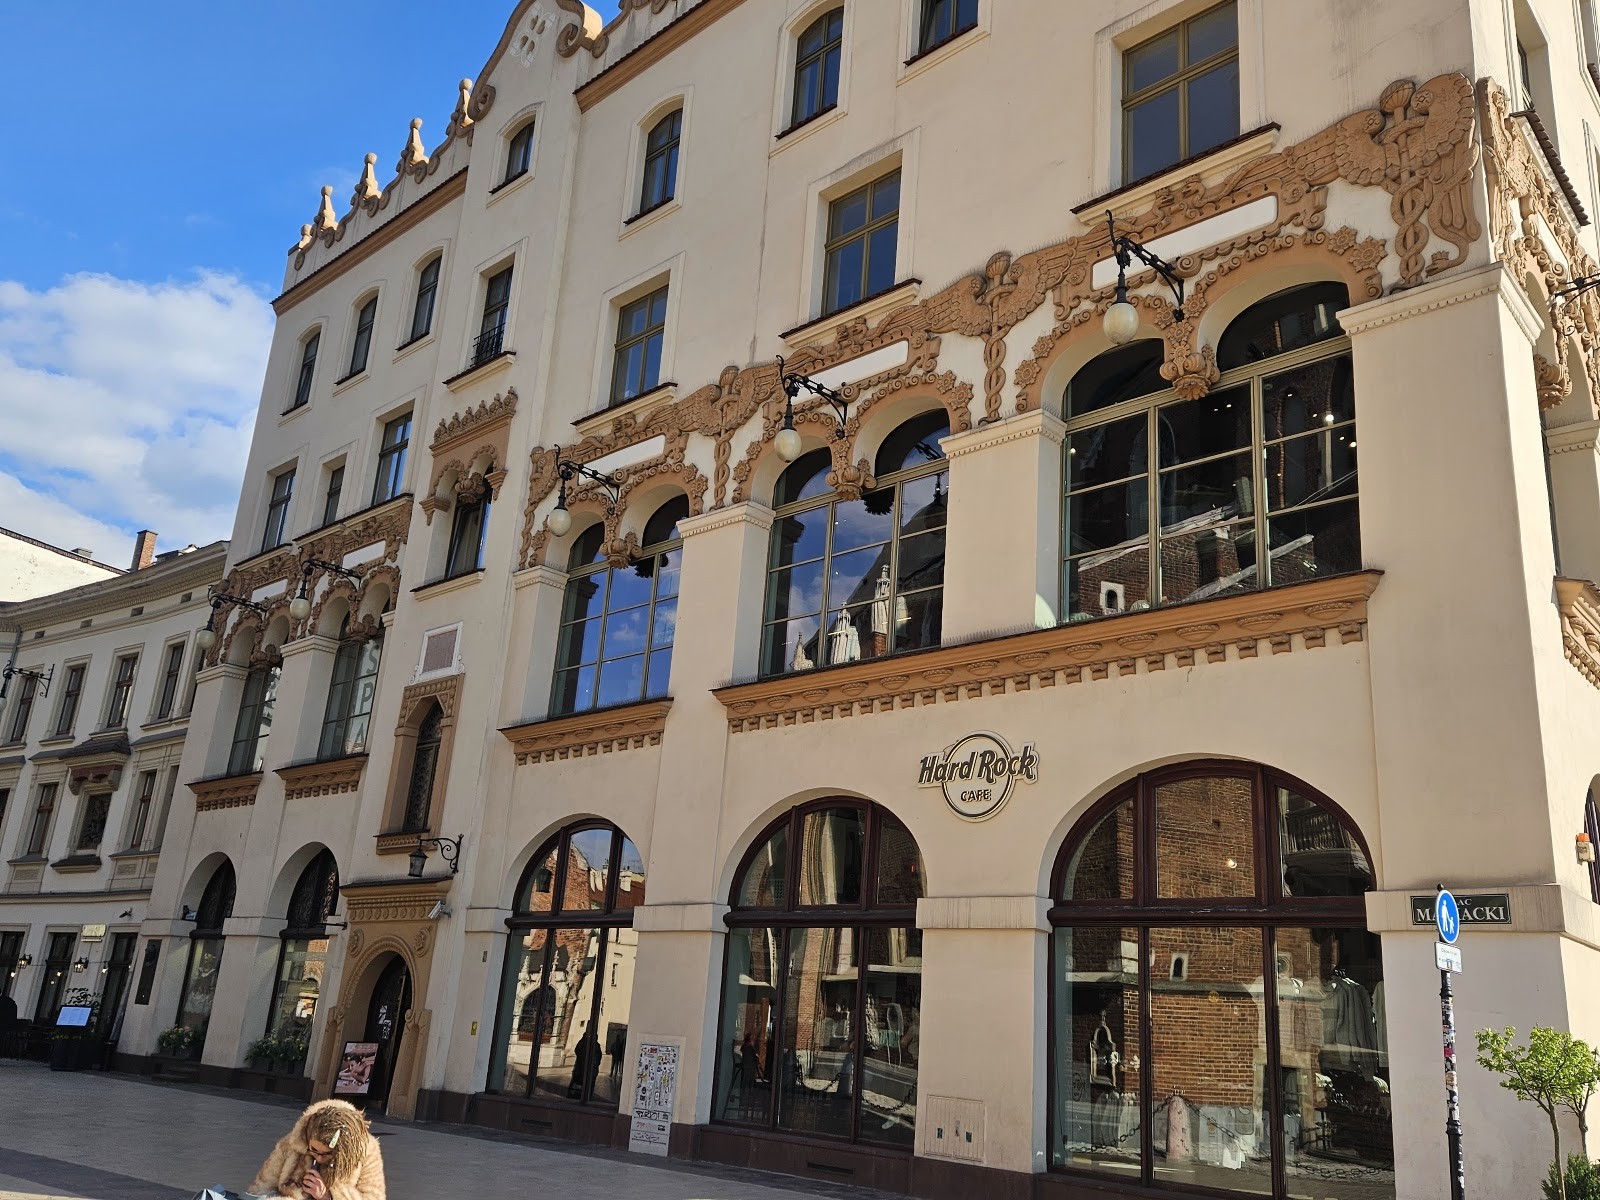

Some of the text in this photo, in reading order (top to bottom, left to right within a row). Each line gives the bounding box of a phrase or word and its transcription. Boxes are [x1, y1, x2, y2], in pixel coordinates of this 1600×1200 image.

[354, 648, 377, 746] SPA
[918, 745, 1036, 784] Hard Rock
[960, 789, 992, 802] CAFE
